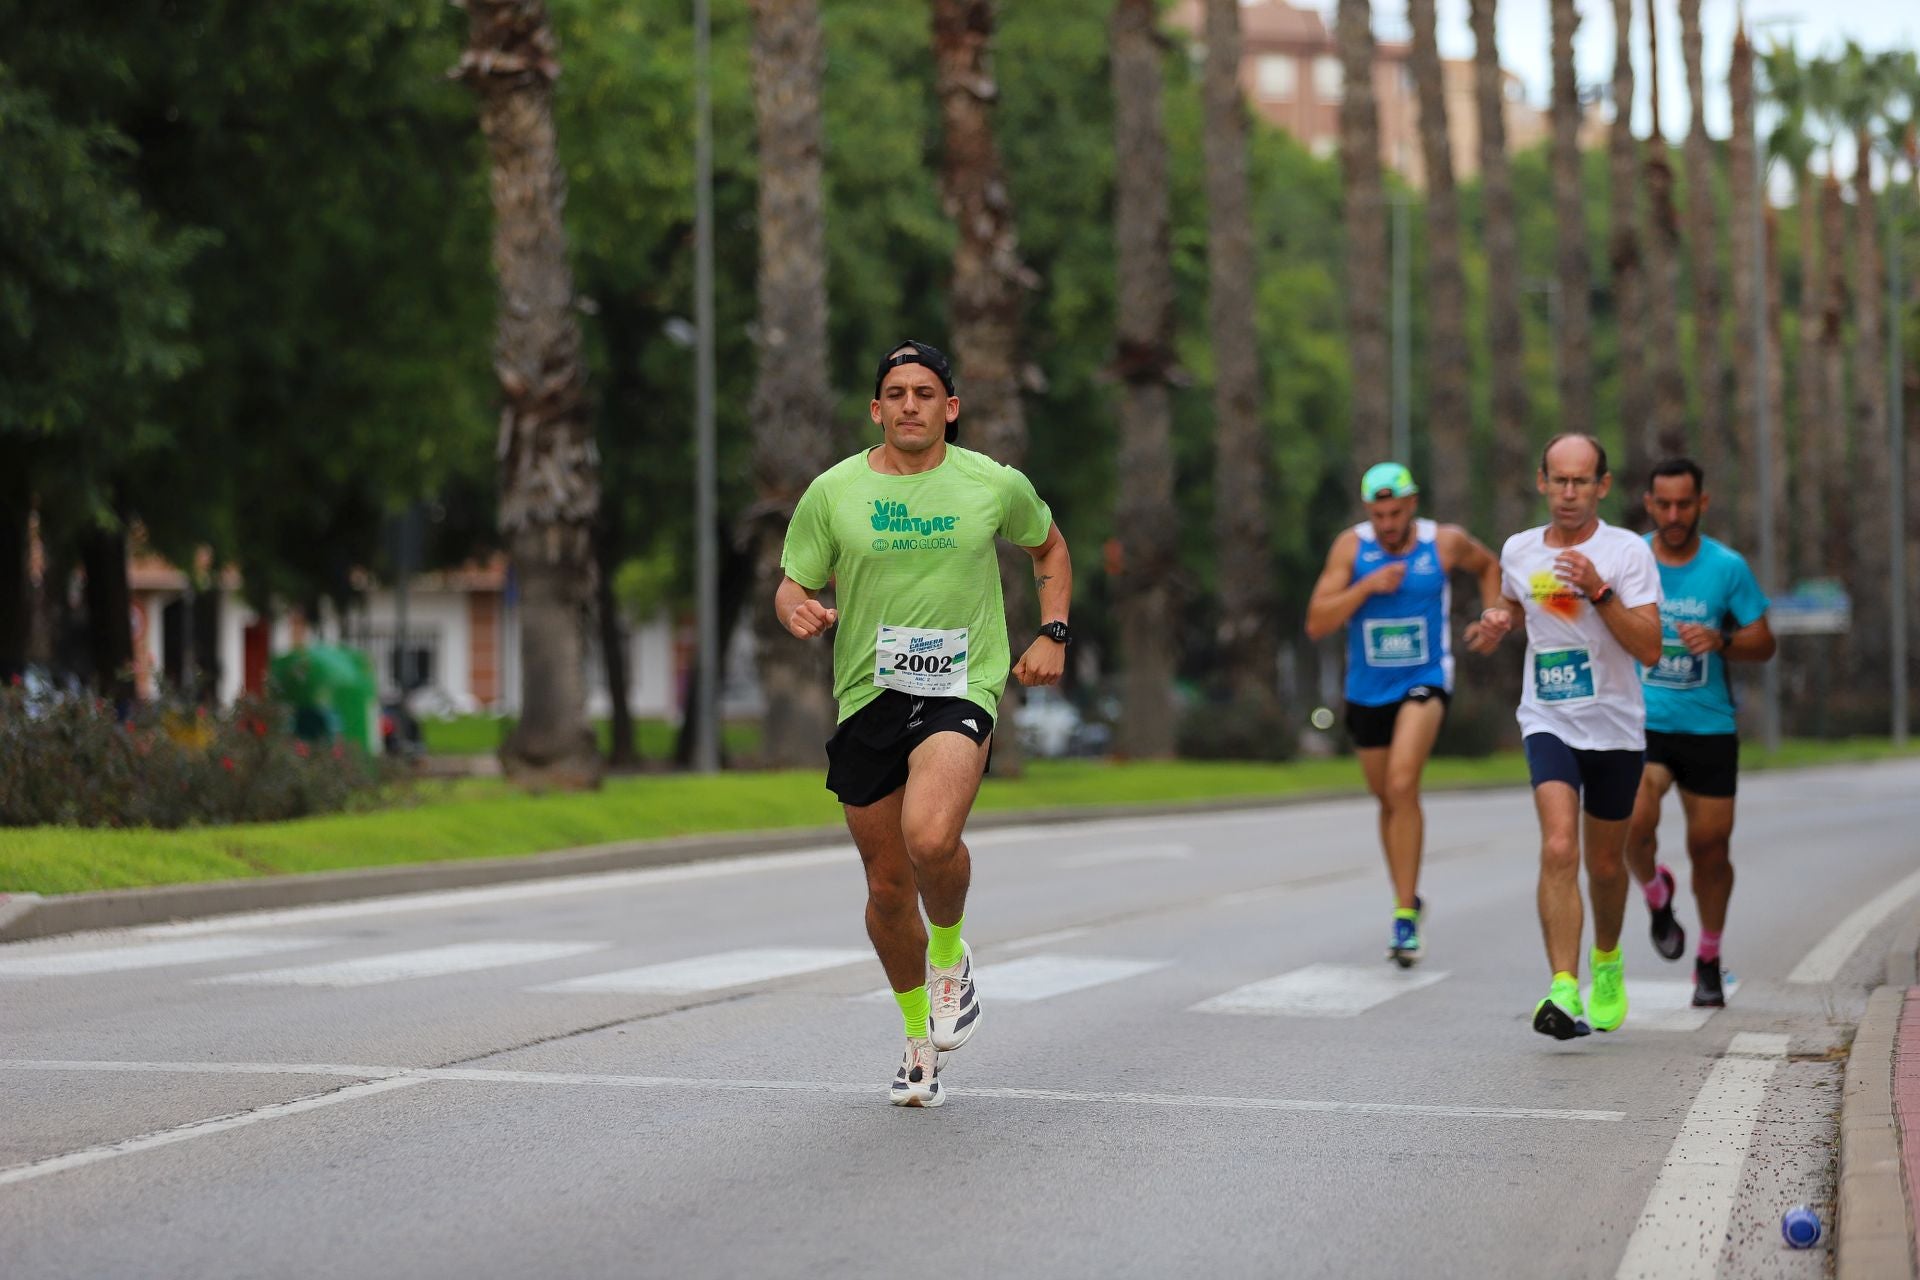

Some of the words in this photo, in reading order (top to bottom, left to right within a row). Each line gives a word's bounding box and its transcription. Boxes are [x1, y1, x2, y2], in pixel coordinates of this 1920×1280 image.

[889, 516, 956, 536] NATURE
[892, 539, 918, 550] AMC
[919, 538, 958, 549] GLOBAL
[894, 653, 952, 673] 2002
[1540, 664, 1577, 685] 985
